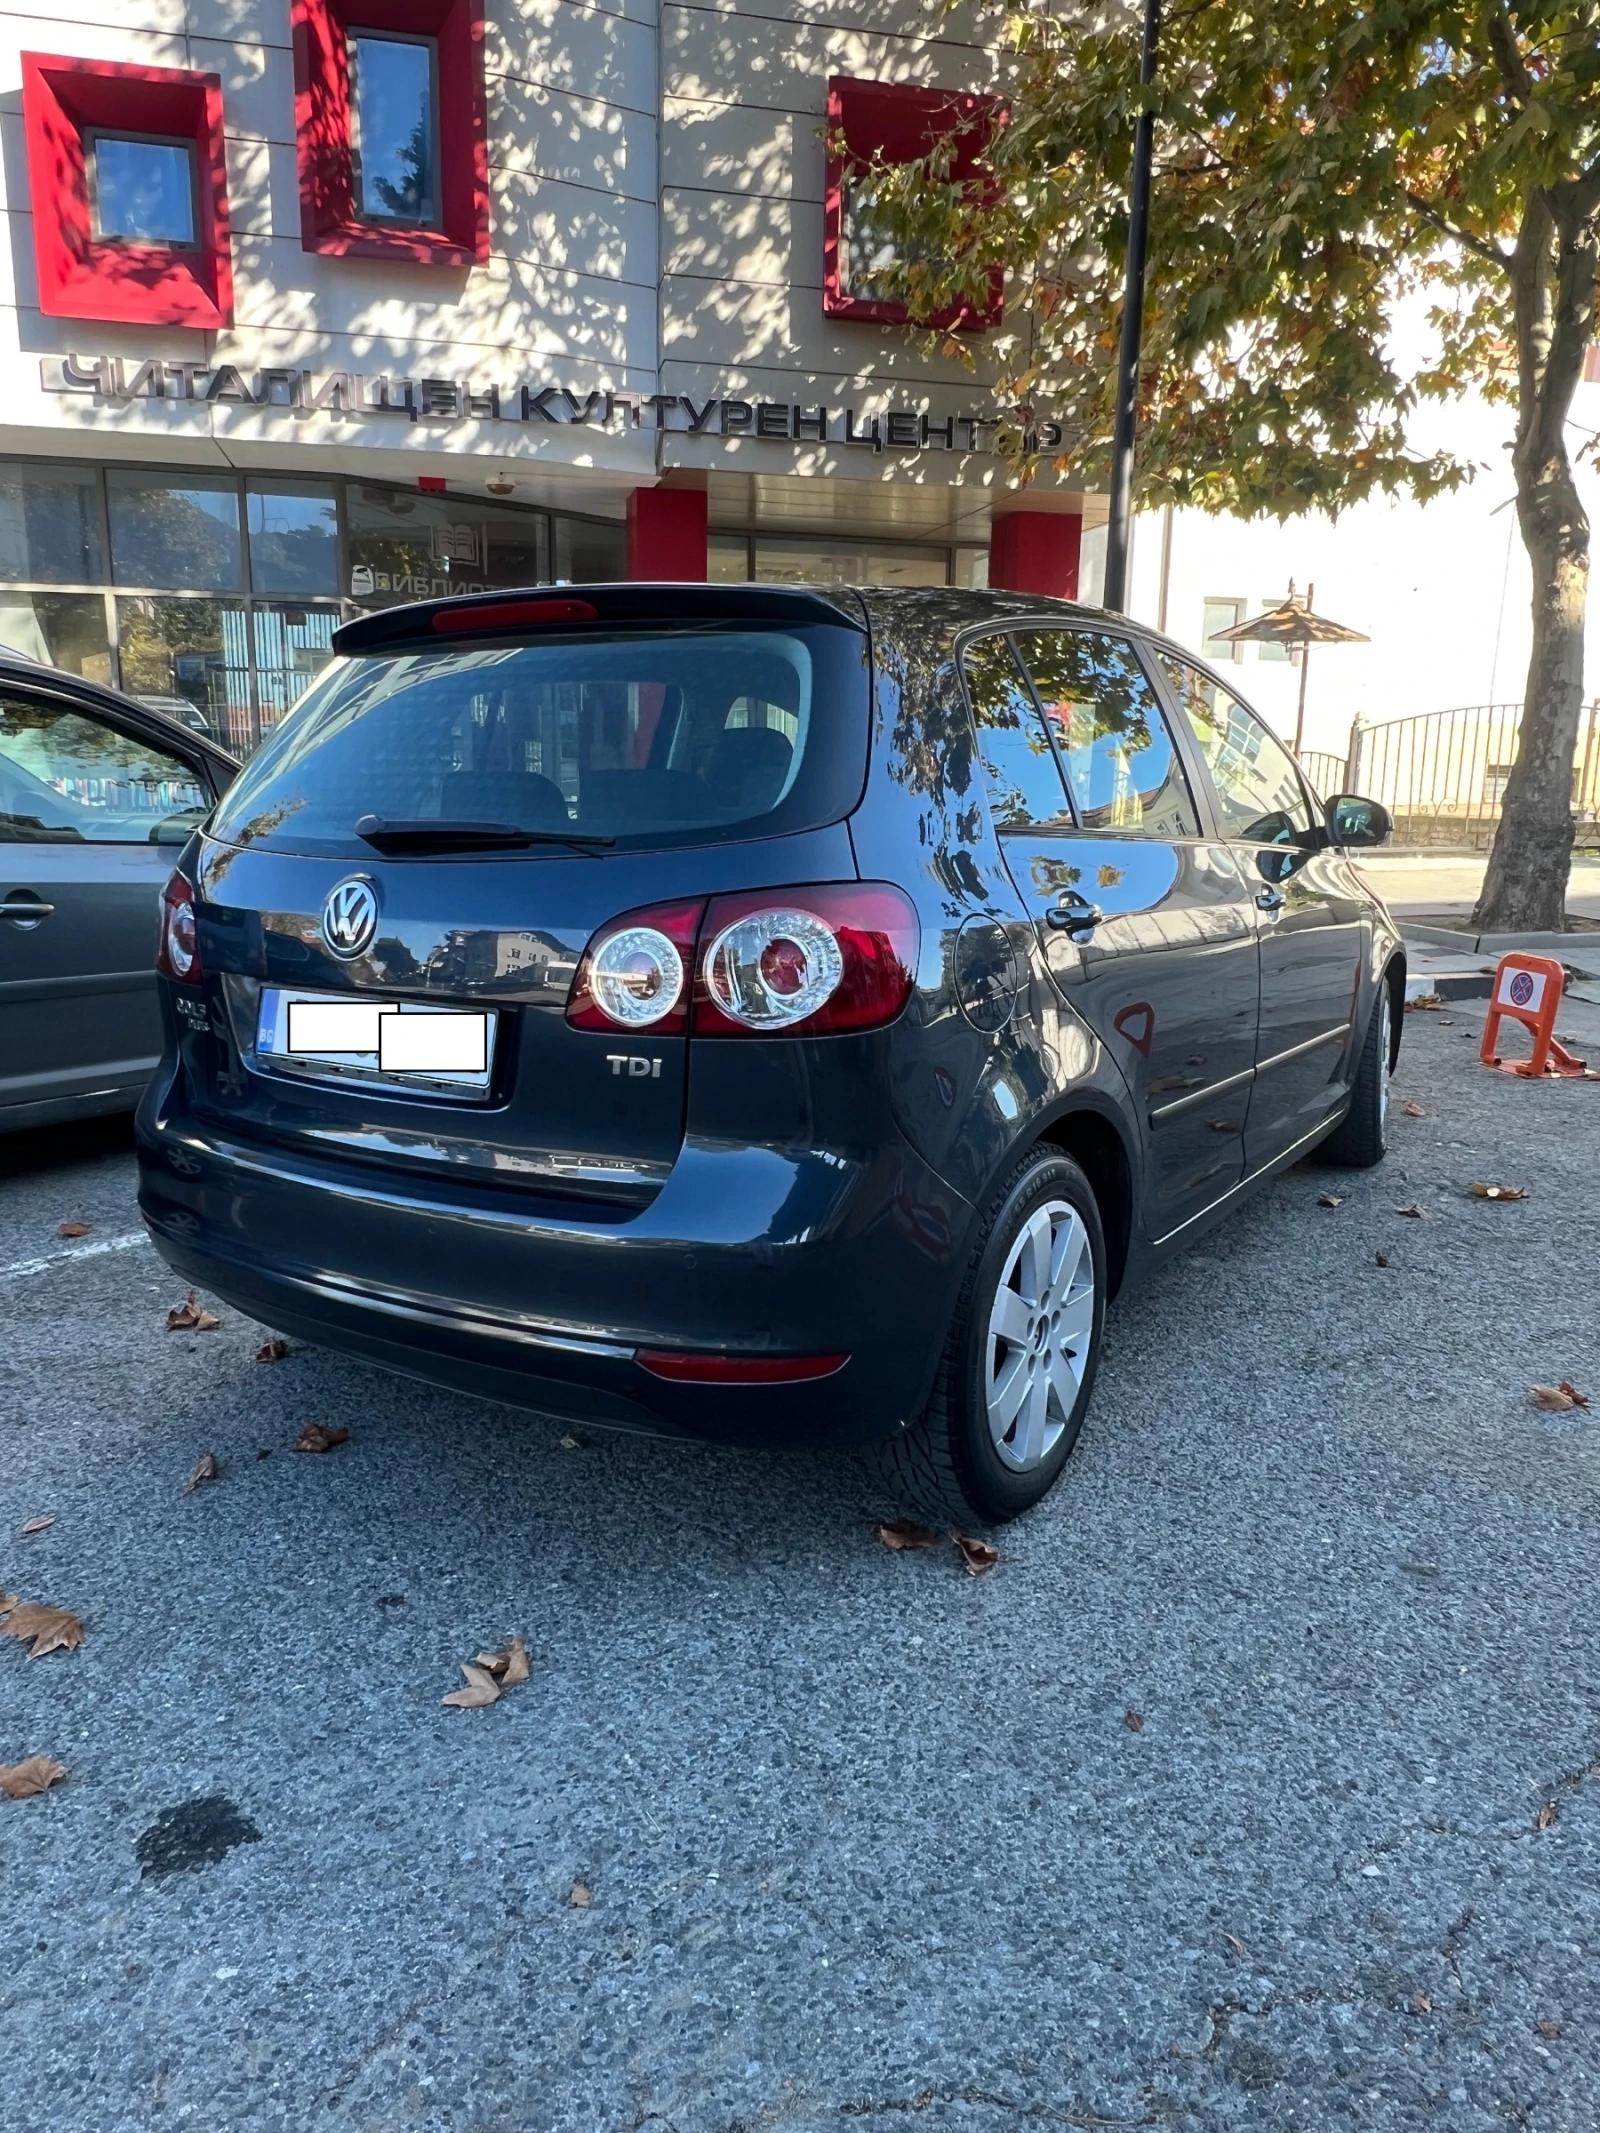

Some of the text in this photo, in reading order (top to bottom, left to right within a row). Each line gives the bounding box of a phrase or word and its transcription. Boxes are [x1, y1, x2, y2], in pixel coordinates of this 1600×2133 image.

[67, 353, 1062, 454] ЧИТАЛИЩЕН КУЛТУРЕН ЦЕНТР
[259, 1028, 275, 1044] BG
